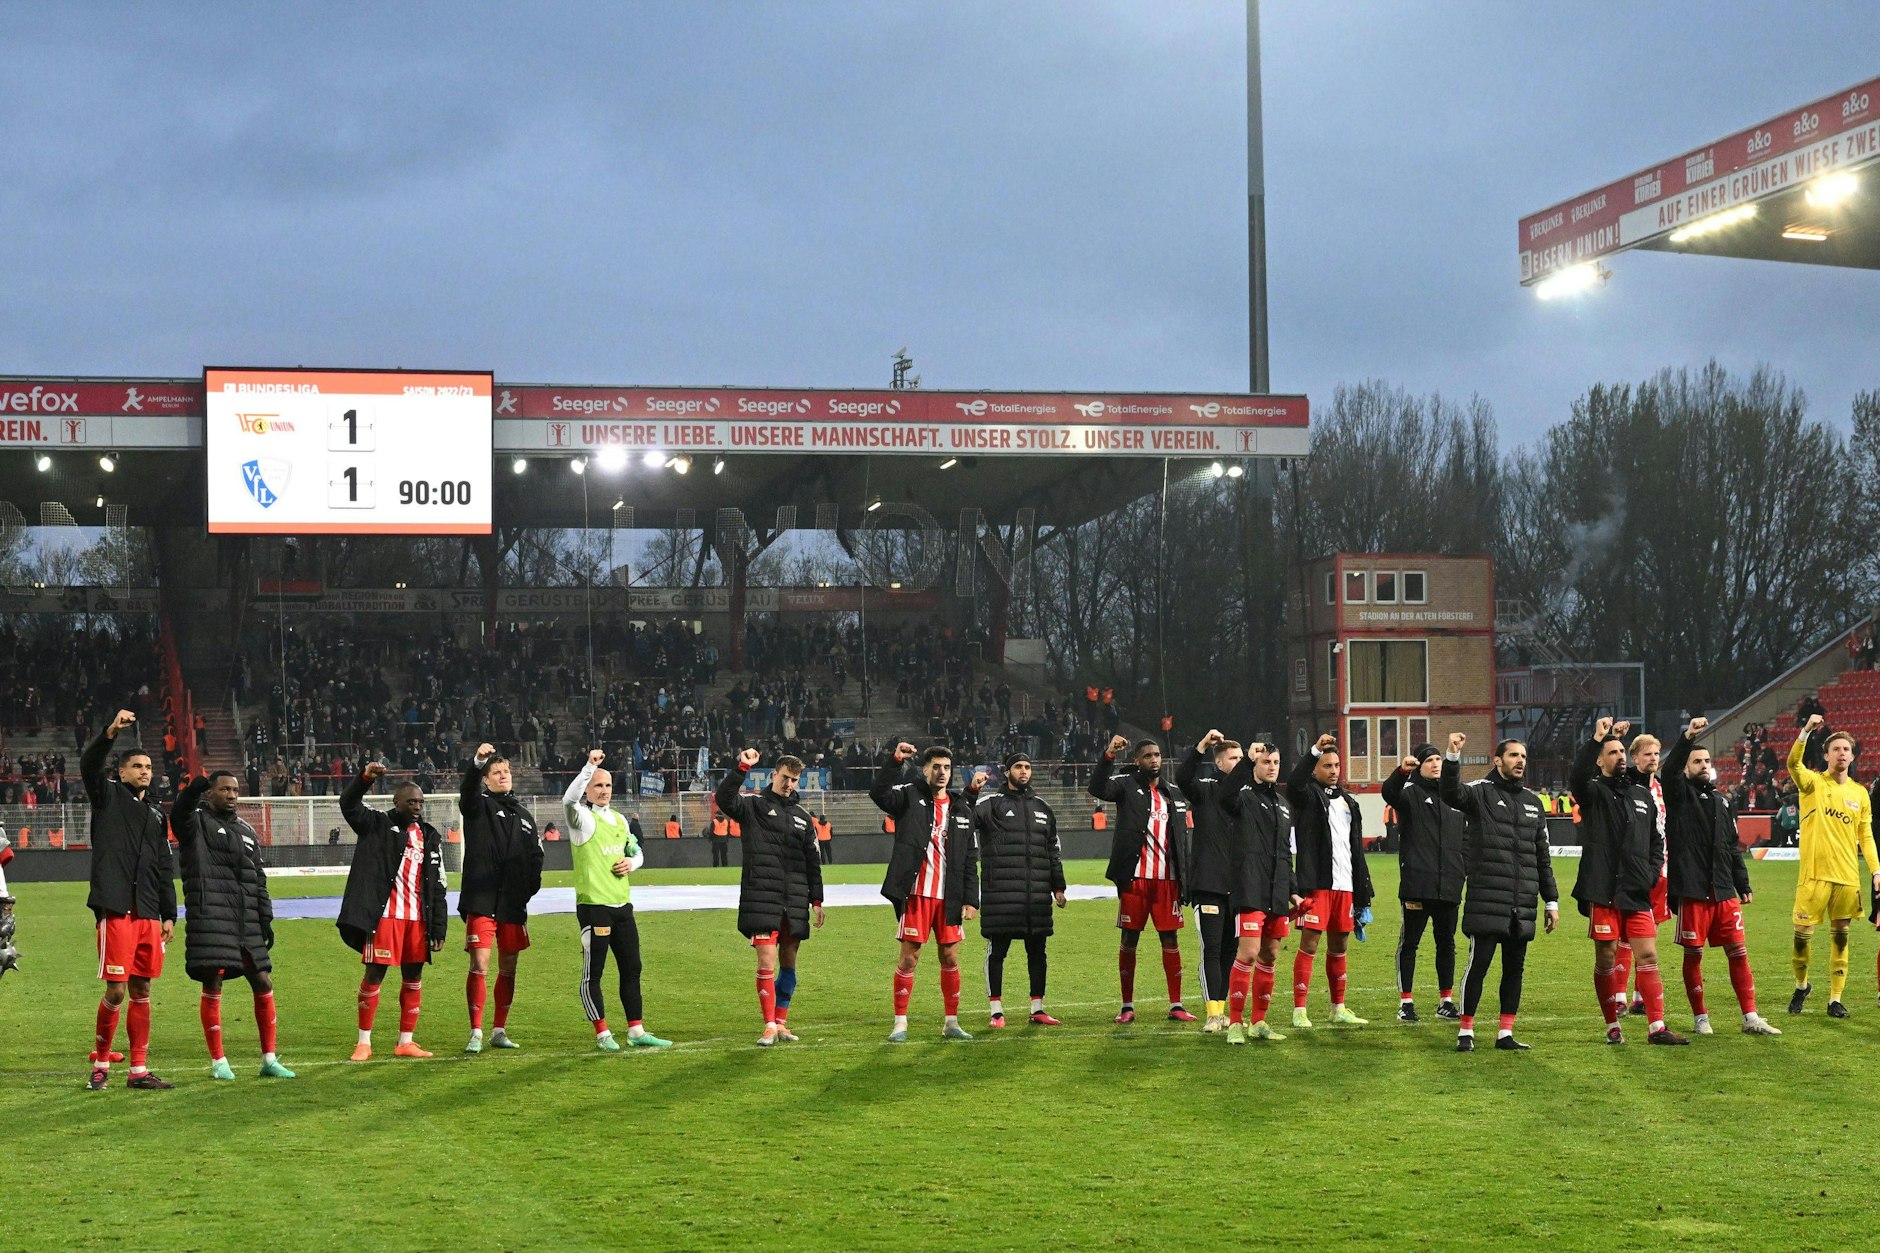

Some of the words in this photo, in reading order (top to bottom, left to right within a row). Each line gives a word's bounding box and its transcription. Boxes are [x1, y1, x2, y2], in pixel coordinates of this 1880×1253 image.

[1842, 92, 1869, 117] a&o
[1793, 112, 1819, 136] a&o
[1747, 130, 1772, 153] a&o
[1659, 199, 1682, 228] AUF
[1688, 183, 1726, 217] EINER
[1733, 160, 1788, 200] GRÜNEN
[1795, 141, 1839, 178] WIESE
[1846, 125, 1880, 160] ZWE
[1533, 240, 1572, 274] EISERN
[1577, 223, 1619, 257] UNION!
[238, 383, 320, 394] BUNDESLIGA
[402, 386, 435, 396] SAISON
[147, 395, 194, 403] AMPELMANN
[552, 395, 610, 415] Seeger
[646, 396, 702, 415] Seeger
[738, 397, 792, 416] Seeger
[829, 398, 883, 417] Seeger
[989, 402, 1056, 415] TotalEnergies
[1107, 404, 1173, 416] TotalEnergies
[1222, 405, 1287, 417] TotalEnergies
[343, 409, 357, 444] 1
[582, 424, 657, 446] UNSERE
[663, 425, 723, 446] LIEBE.
[731, 426, 805, 447] UNSERE
[811, 427, 943, 449] MANNSCHAFT.
[951, 428, 1015, 449] UNSER
[1017, 429, 1077, 449] STOLZ.
[1085, 430, 1144, 450] UNSER
[1151, 430, 1220, 451] VEREIN.
[243, 465, 274, 504] VfL
[343, 466, 357, 502] 1
[399, 480, 471, 505] 90:00
[1359, 611, 1389, 621] STADION
[1390, 612, 1400, 621] AN
[1400, 612, 1415, 621] DER
[1415, 612, 1437, 621] ALTEN
